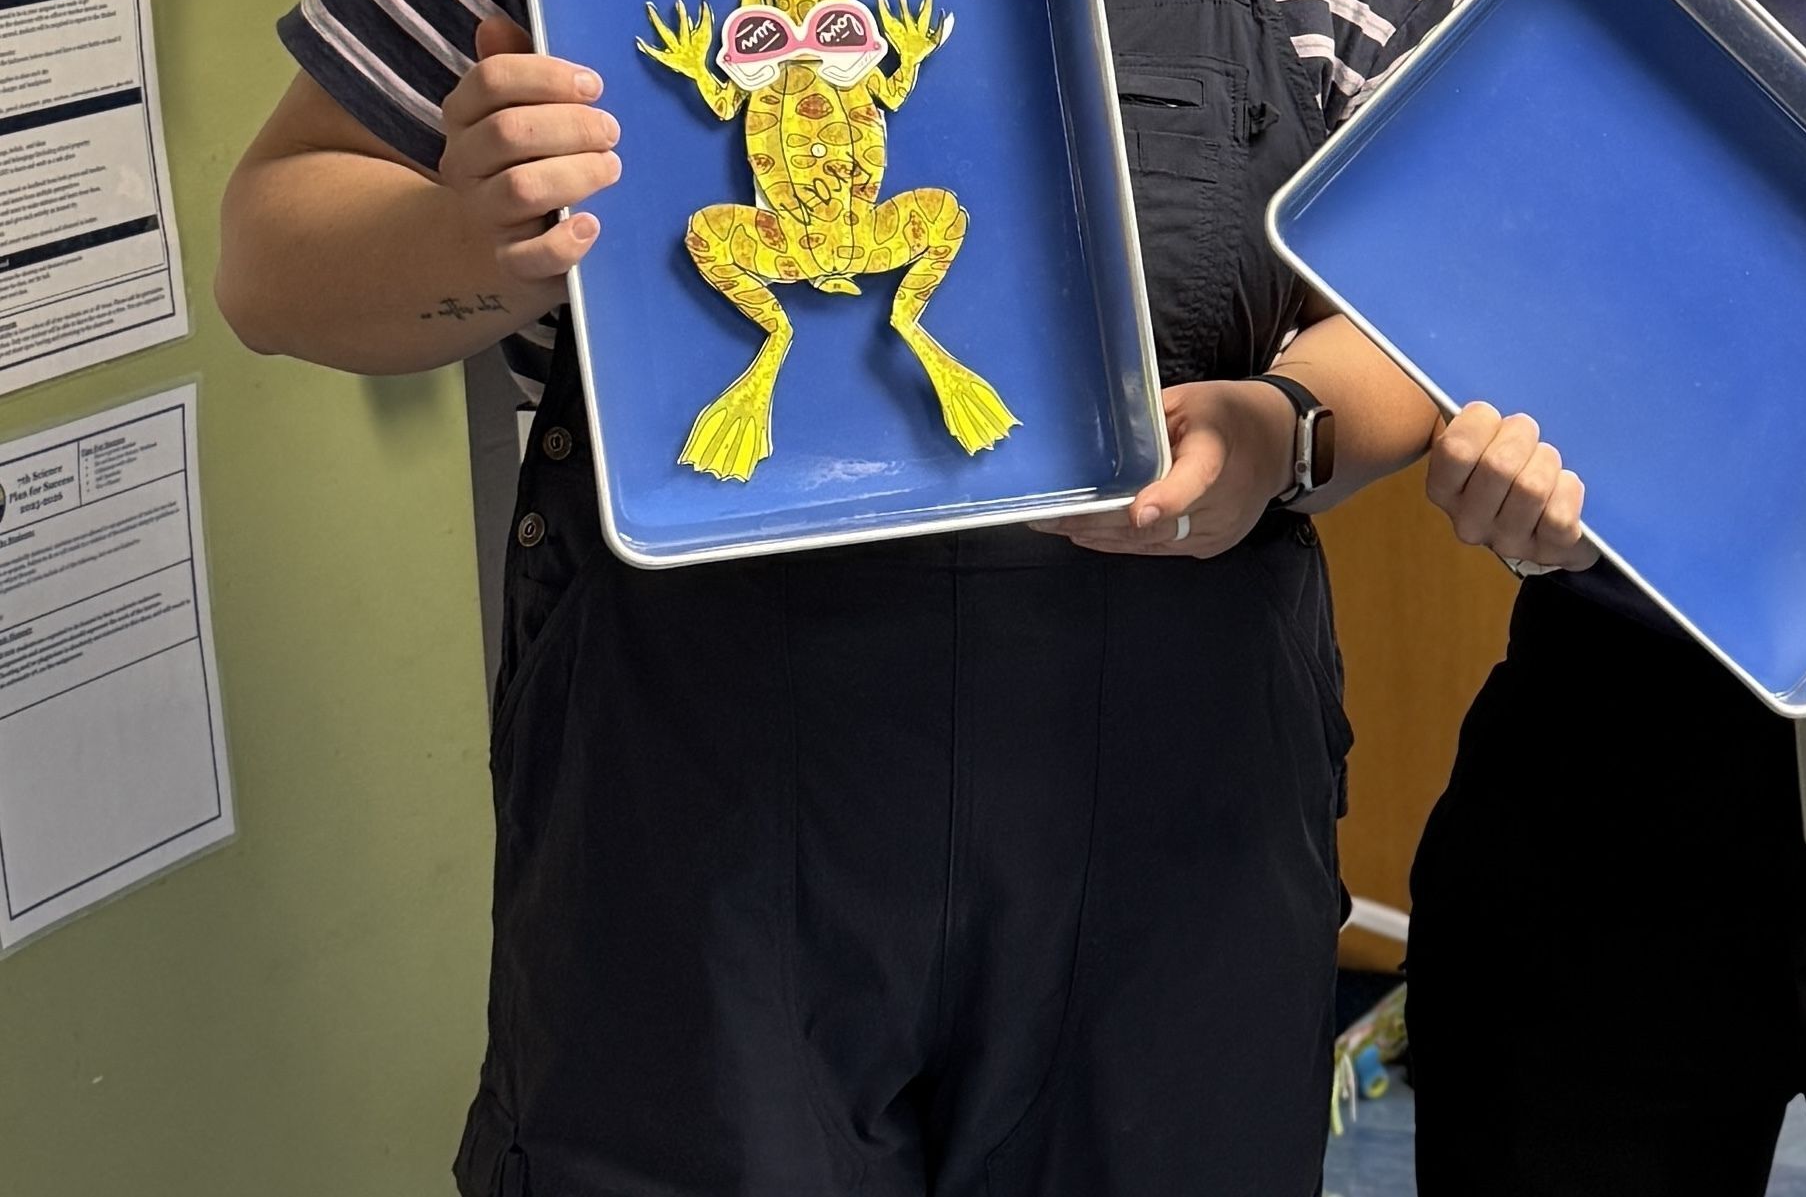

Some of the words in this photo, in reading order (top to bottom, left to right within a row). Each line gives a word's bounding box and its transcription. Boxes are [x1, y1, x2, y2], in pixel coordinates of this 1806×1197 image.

[32, 465, 63, 481] Science
[9, 490, 27, 504] Plan
[29, 486, 41, 498] for
[43, 475, 75, 491] Success
